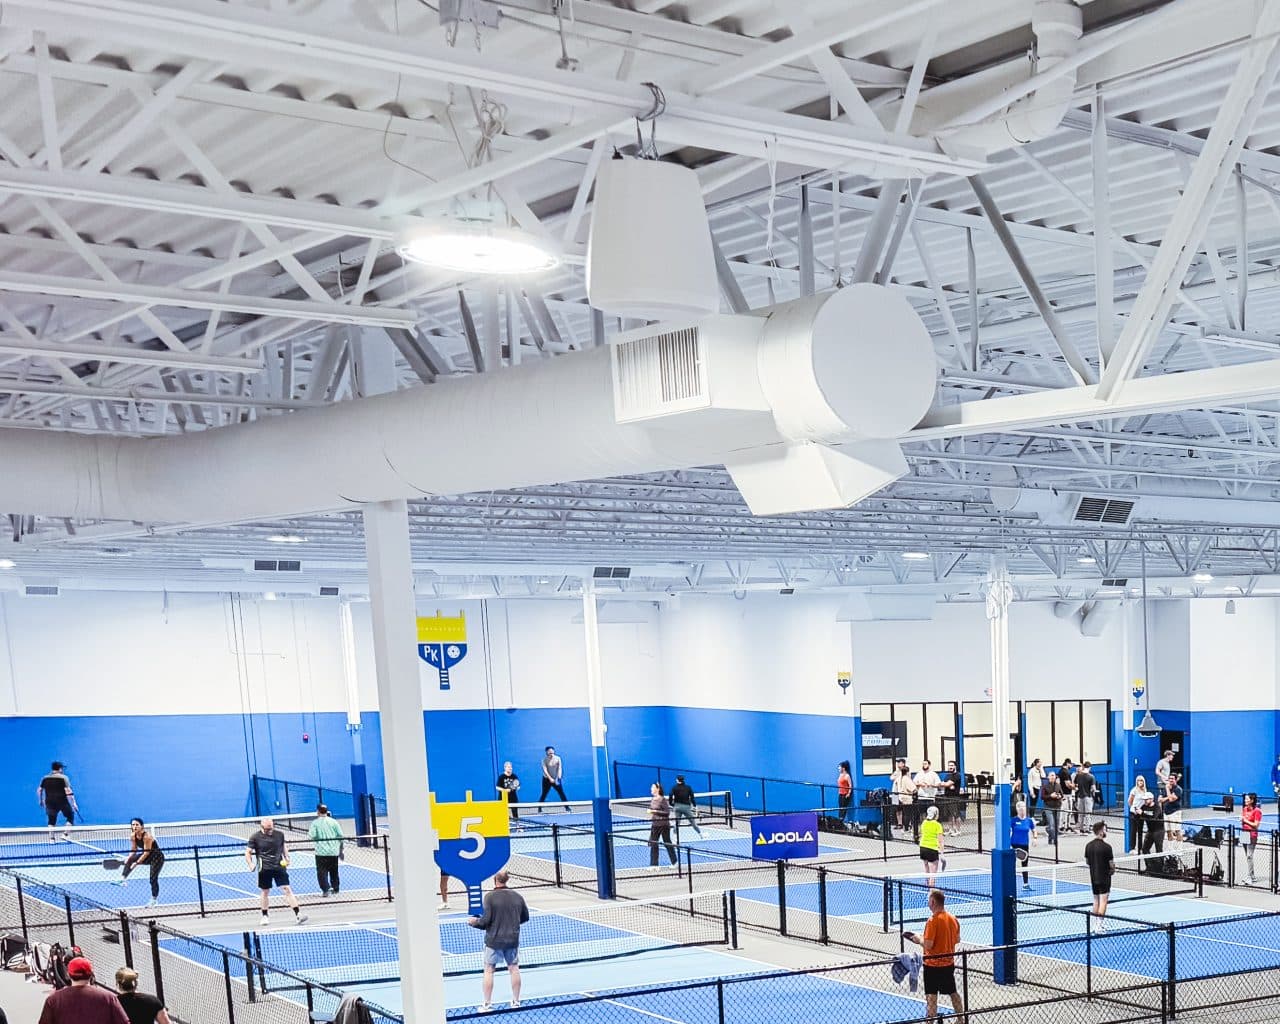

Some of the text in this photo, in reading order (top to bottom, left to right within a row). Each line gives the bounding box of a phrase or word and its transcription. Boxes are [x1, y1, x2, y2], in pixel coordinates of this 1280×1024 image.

[423, 645, 439, 662] PK
[458, 816, 486, 860] 5
[767, 831, 814, 844] JOOLA
